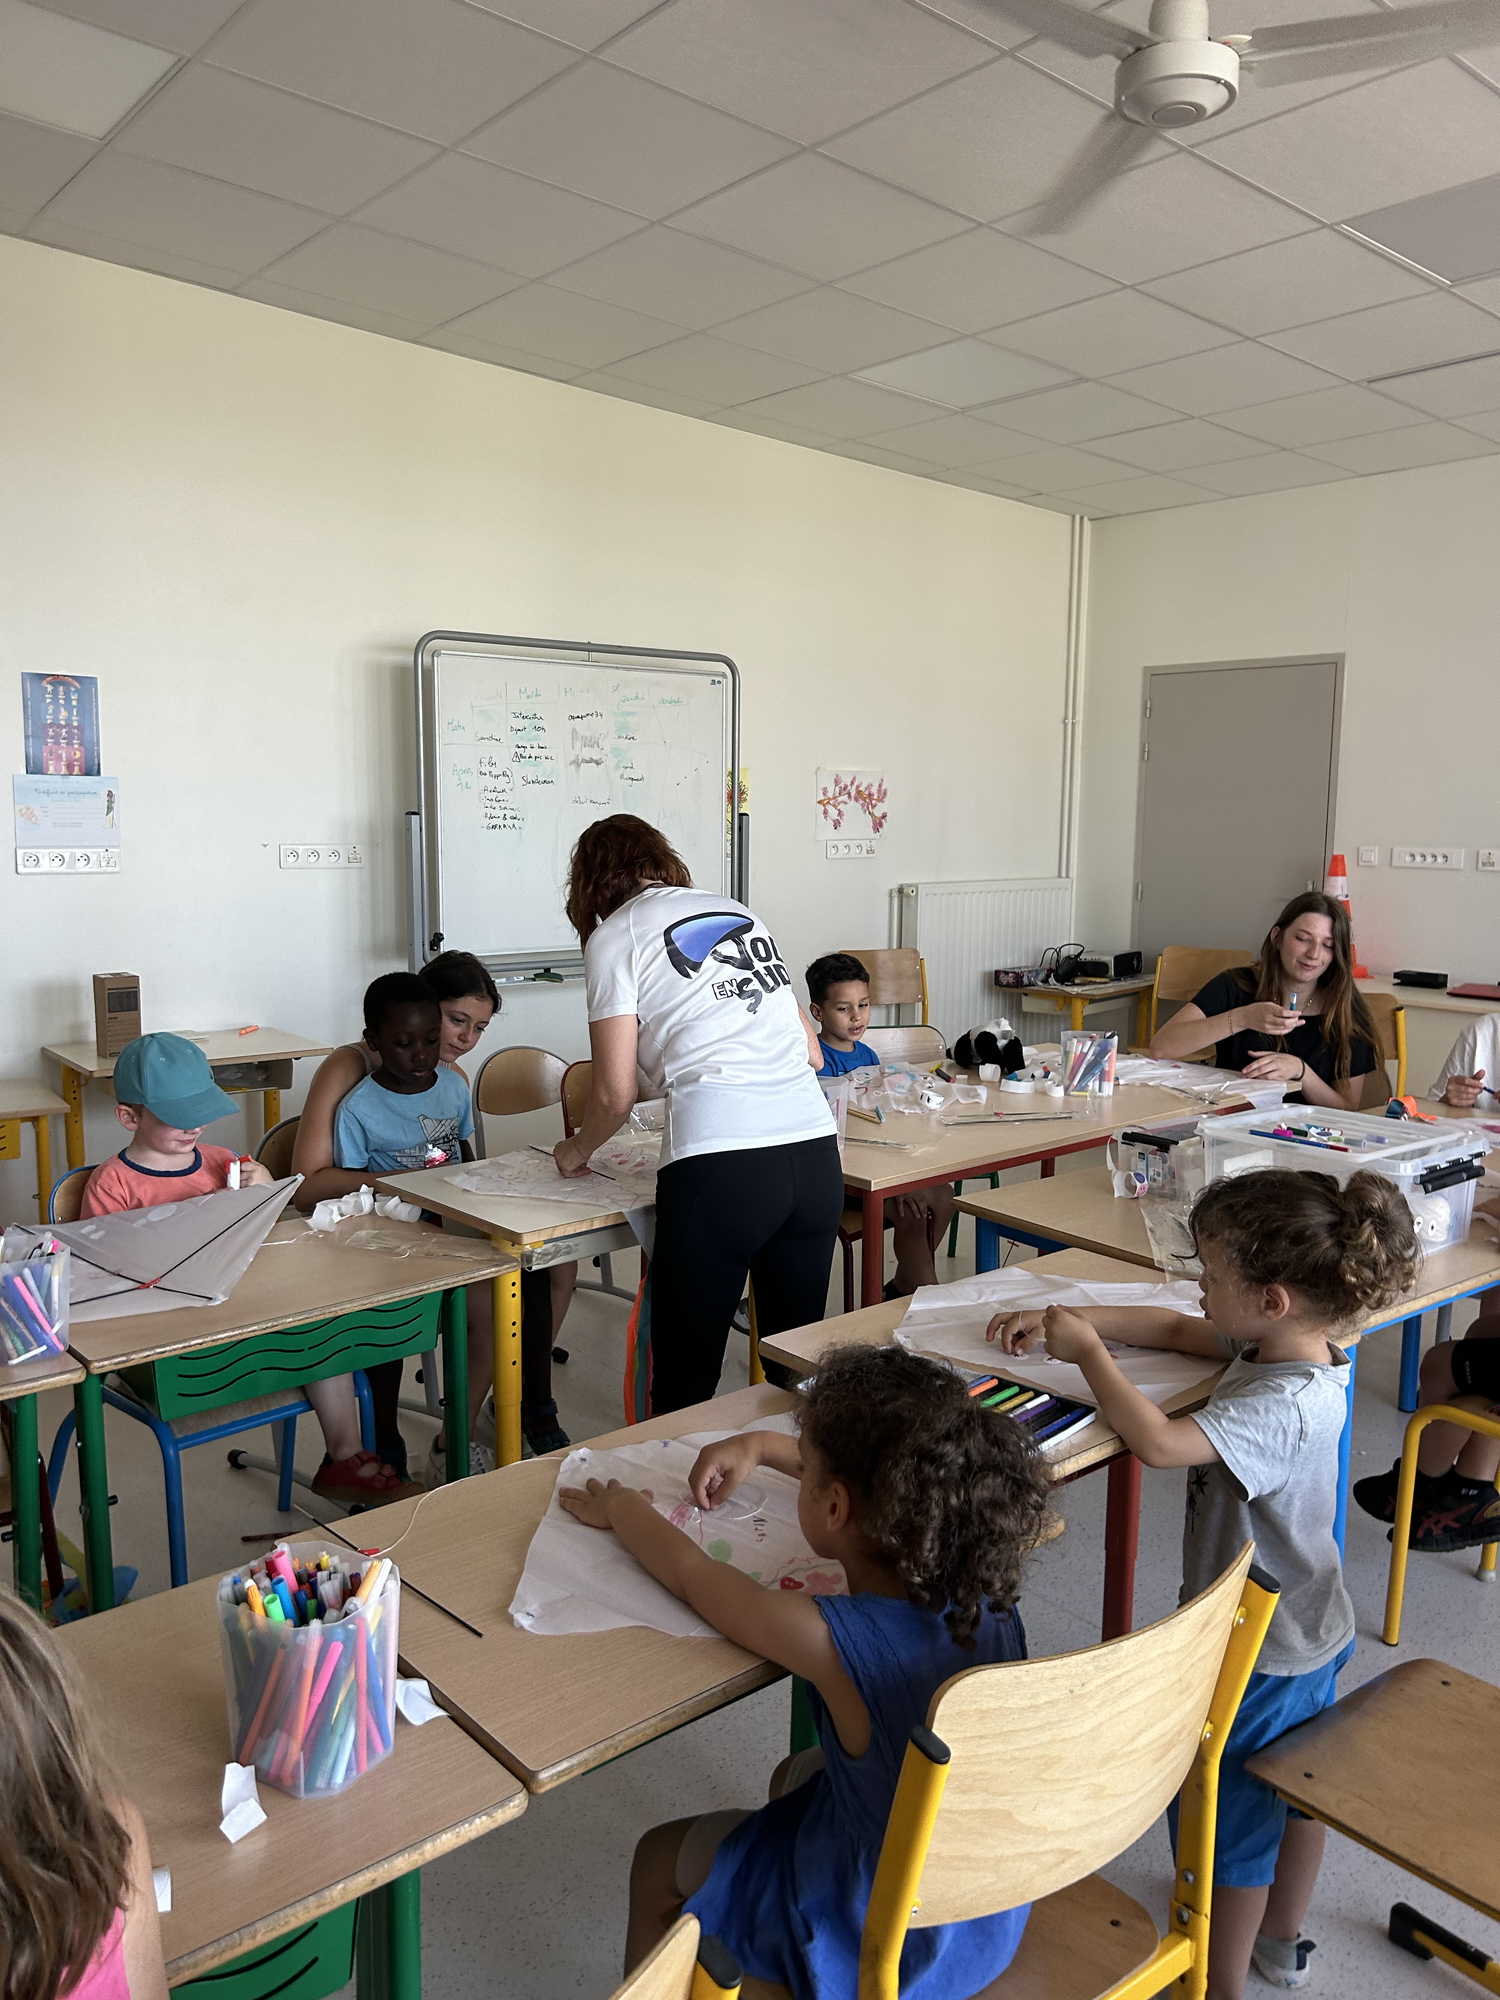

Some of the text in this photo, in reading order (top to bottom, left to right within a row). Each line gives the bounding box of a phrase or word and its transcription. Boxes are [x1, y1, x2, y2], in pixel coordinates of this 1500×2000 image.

[518, 686, 542, 699] Mardi
[447, 718, 465, 732] Matin
[452, 763, 474, 781] Après
